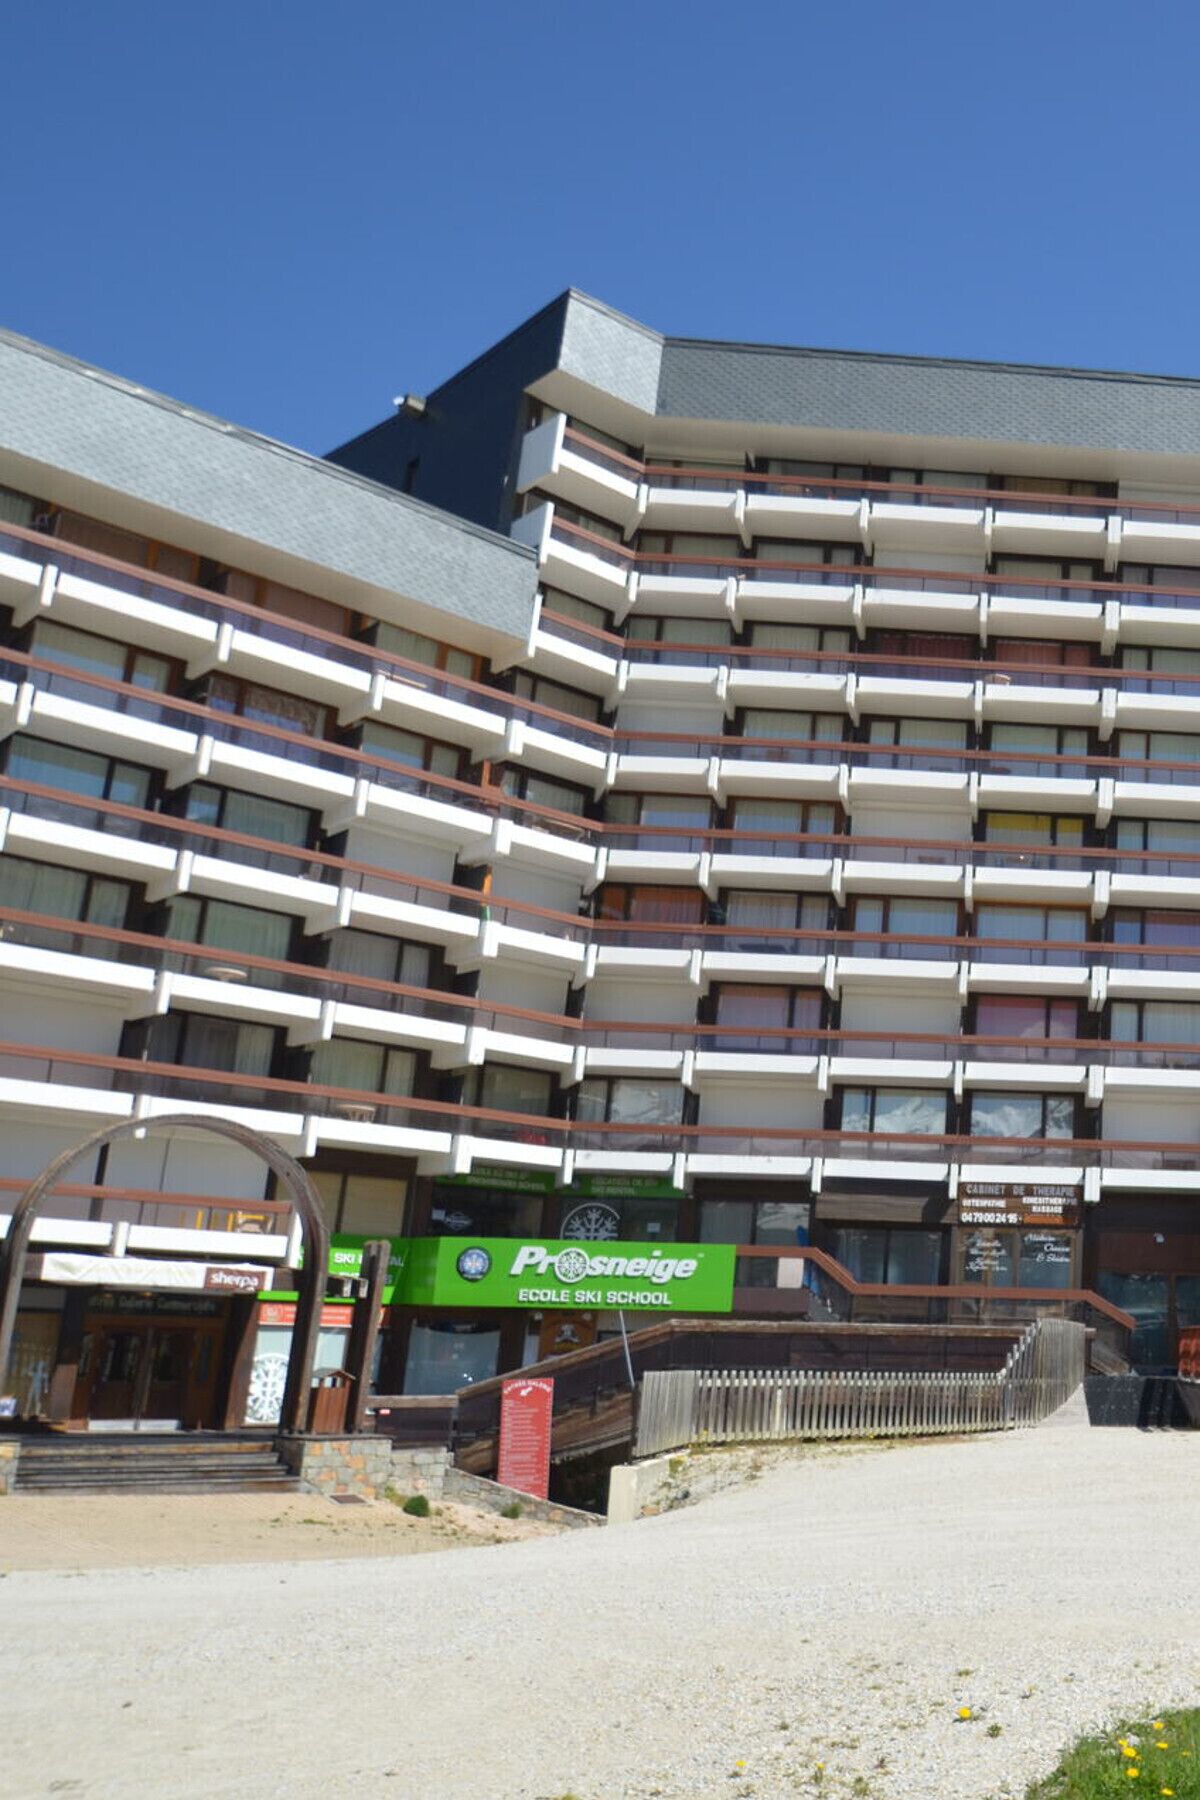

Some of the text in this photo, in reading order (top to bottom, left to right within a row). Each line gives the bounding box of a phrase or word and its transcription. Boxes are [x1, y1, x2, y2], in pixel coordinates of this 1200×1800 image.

[965, 1184, 1005, 1196] CABINET
[1012, 1186, 1025, 1197] DE
[334, 1253, 355, 1264] SKI
[510, 1246, 699, 1283] Prosneige
[211, 1270, 259, 1288] sherpa
[518, 1289, 673, 1305] ECOLE SKI SCHOOL
